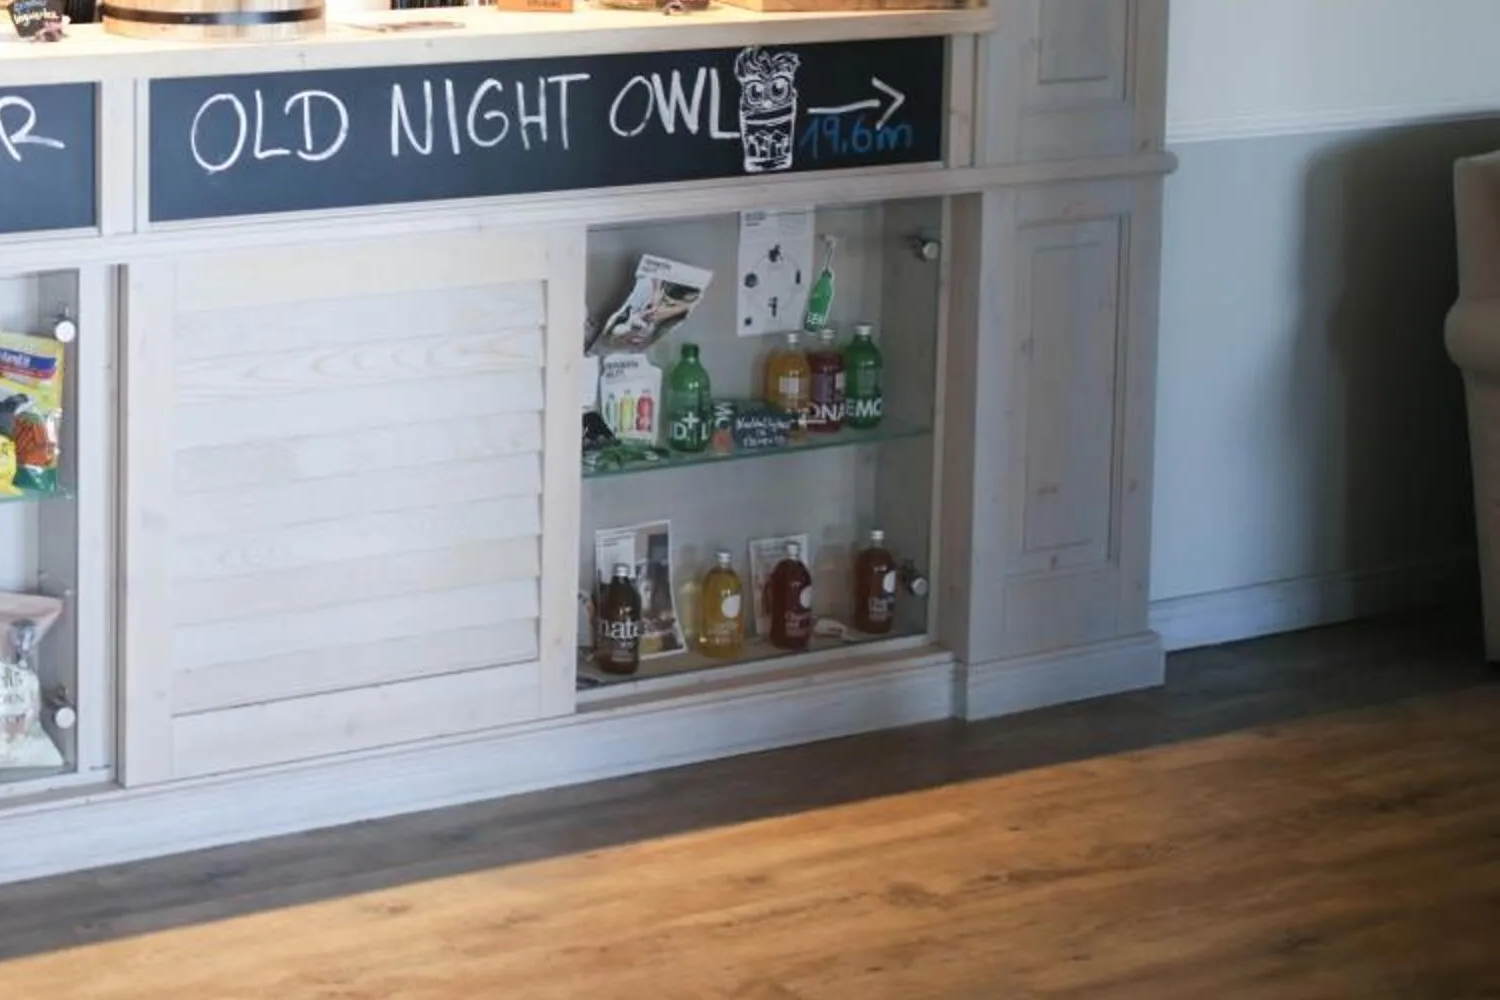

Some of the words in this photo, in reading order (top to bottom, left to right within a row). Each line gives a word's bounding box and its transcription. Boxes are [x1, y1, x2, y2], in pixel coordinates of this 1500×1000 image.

[190, 88, 350, 174] OLD
[390, 73, 591, 158] NIGHT
[609, 67, 741, 139] OWL
